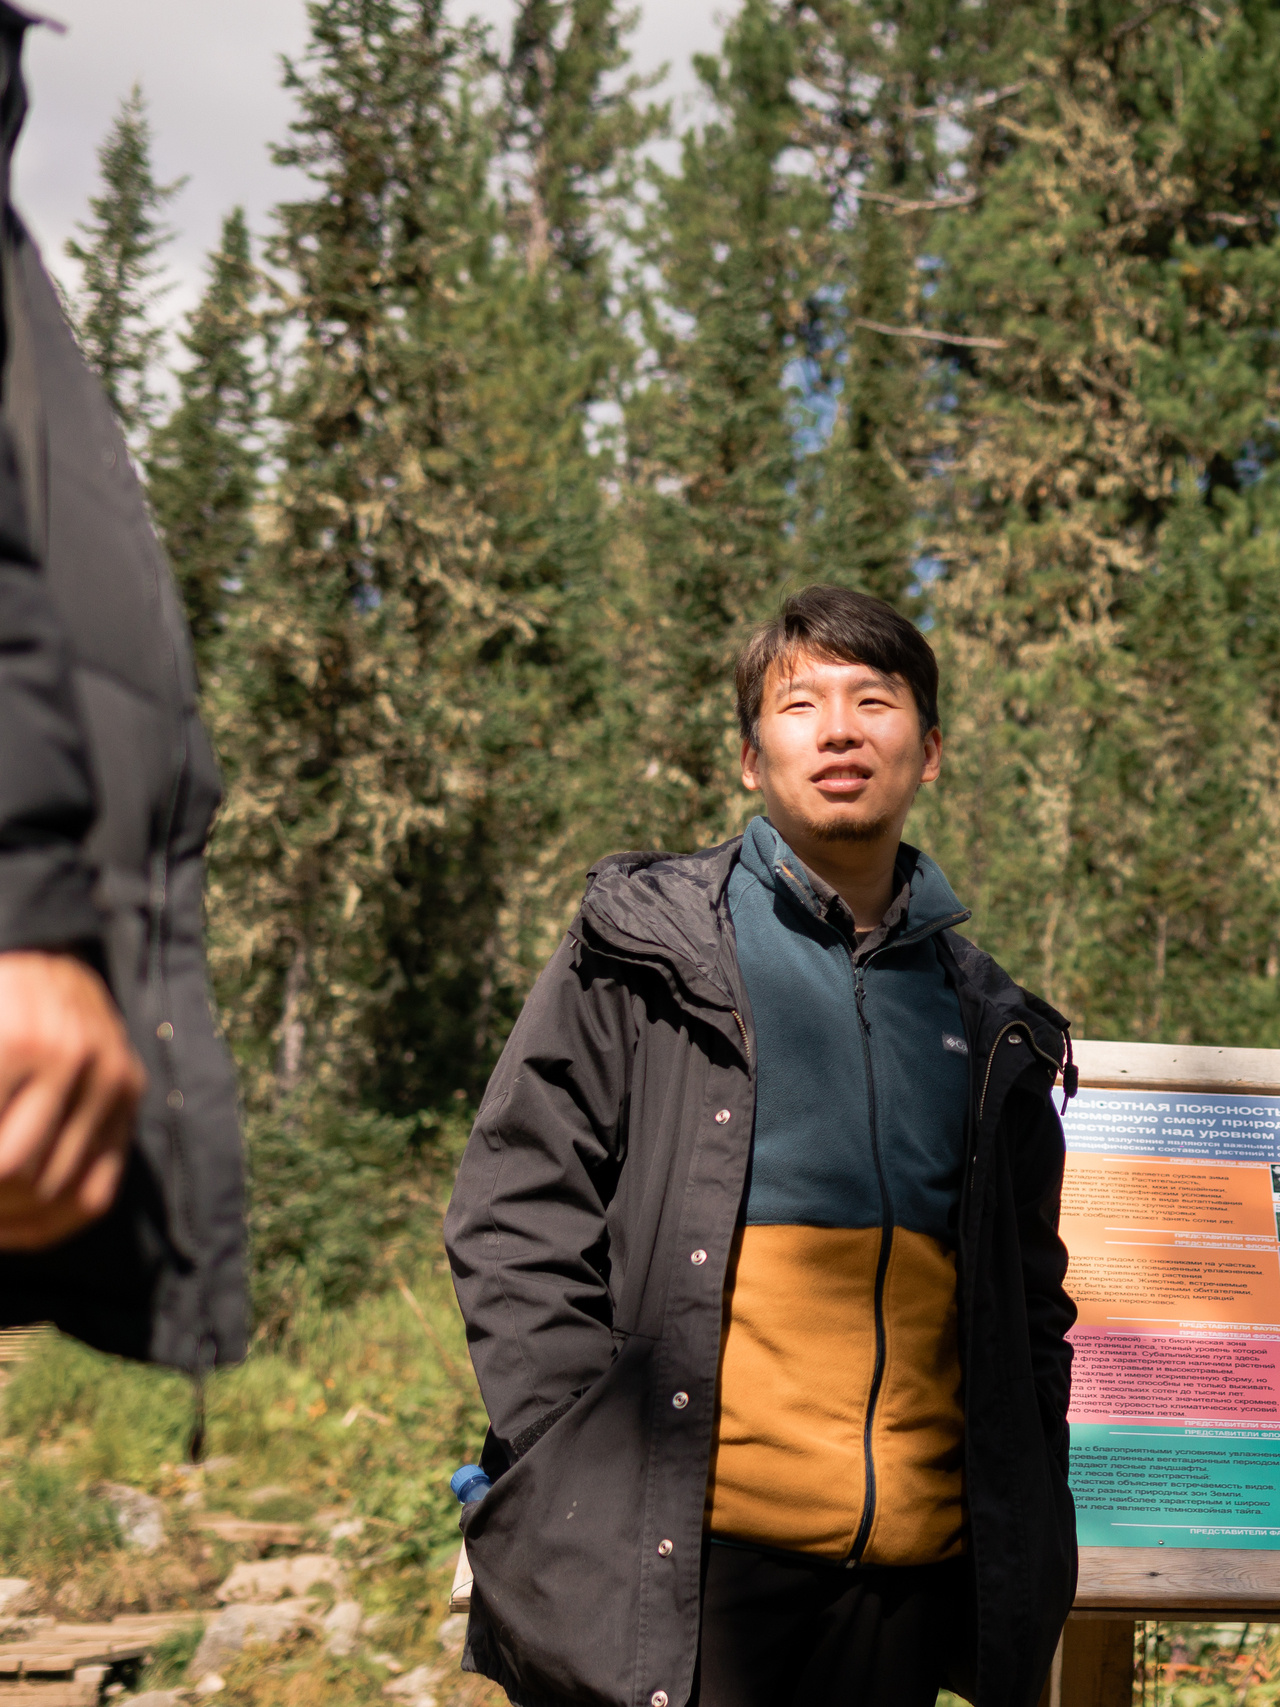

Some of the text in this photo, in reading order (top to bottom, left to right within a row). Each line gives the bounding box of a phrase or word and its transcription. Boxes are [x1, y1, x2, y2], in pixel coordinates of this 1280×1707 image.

[1066, 1099, 1170, 1112] ВЫСОТНАЯ
[1163, 1116, 1216, 1129] смену
[1161, 1127, 1194, 1139] над
[1198, 1129, 1274, 1143] уровнем
[1107, 1136, 1164, 1147] излучение
[1167, 1139, 1220, 1148] являются
[1223, 1142, 1273, 1150] важными
[1068, 1140, 1154, 1154] специфическим
[1158, 1146, 1209, 1154] составом
[1214, 1147, 1264, 1159] растений
[1170, 1158, 1236, 1166] ПРЕДСТАВИТЕЛИ
[1174, 1240, 1243, 1248] ПРЕДСТАВИТЕЛИ
[1179, 1322, 1250, 1330] ПРЕДСТАВИТЕЛИ
[1072, 1333, 1141, 1344] (горно-луговой)
[1168, 1336, 1223, 1346] биотическая
[1179, 1330, 1251, 1338] ПРЕДСТАВИТЕЛИ
[1094, 1342, 1131, 1351] границы
[1160, 1343, 1191, 1352] точный
[1194, 1346, 1230, 1355] уровень
[1232, 1346, 1267, 1356] которой
[1141, 1350, 1210, 1361] Субальпийские
[1213, 1354, 1232, 1362] луга
[1080, 1355, 1109, 1365] флора
[1112, 1357, 1185, 1367] характеризуется
[1234, 1360, 1275, 1371] растений
[1091, 1364, 1153, 1374] разнотравьем
[1079, 1370, 1113, 1378] чахлые
[1155, 1373, 1219, 1383] искривленную
[1136, 1378, 1180, 1387] способны
[1100, 1393, 1126, 1401] здесь
[1128, 1394, 1172, 1402] животных
[1176, 1396, 1232, 1404] значительно
[1112, 1409, 1154, 1418] коротким
[1114, 1402, 1167, 1411] суровостью
[1170, 1404, 1237, 1412] климатических
[1240, 1404, 1277, 1414] условий
[1185, 1429, 1259, 1437] ПРЕДСТАВИТЕЛИ
[1092, 1444, 1172, 1456] благоприятными
[1174, 1449, 1226, 1458] условиями
[1110, 1455, 1154, 1464] длинным
[1156, 1456, 1230, 1466] вегетационным
[1116, 1470, 1145, 1478] более
[1072, 1478, 1114, 1488] участков
[1117, 1478, 1167, 1488] объясняет
[1170, 1482, 1242, 1492] встречаемость
[1097, 1487, 1131, 1496] разных
[1135, 1489, 1187, 1498] природных
[1109, 1495, 1156, 1504] наиболее
[1159, 1498, 1222, 1507] характерным
[1234, 1500, 1270, 1508] широко
[1164, 1504, 1232, 1514] темнохвойная
